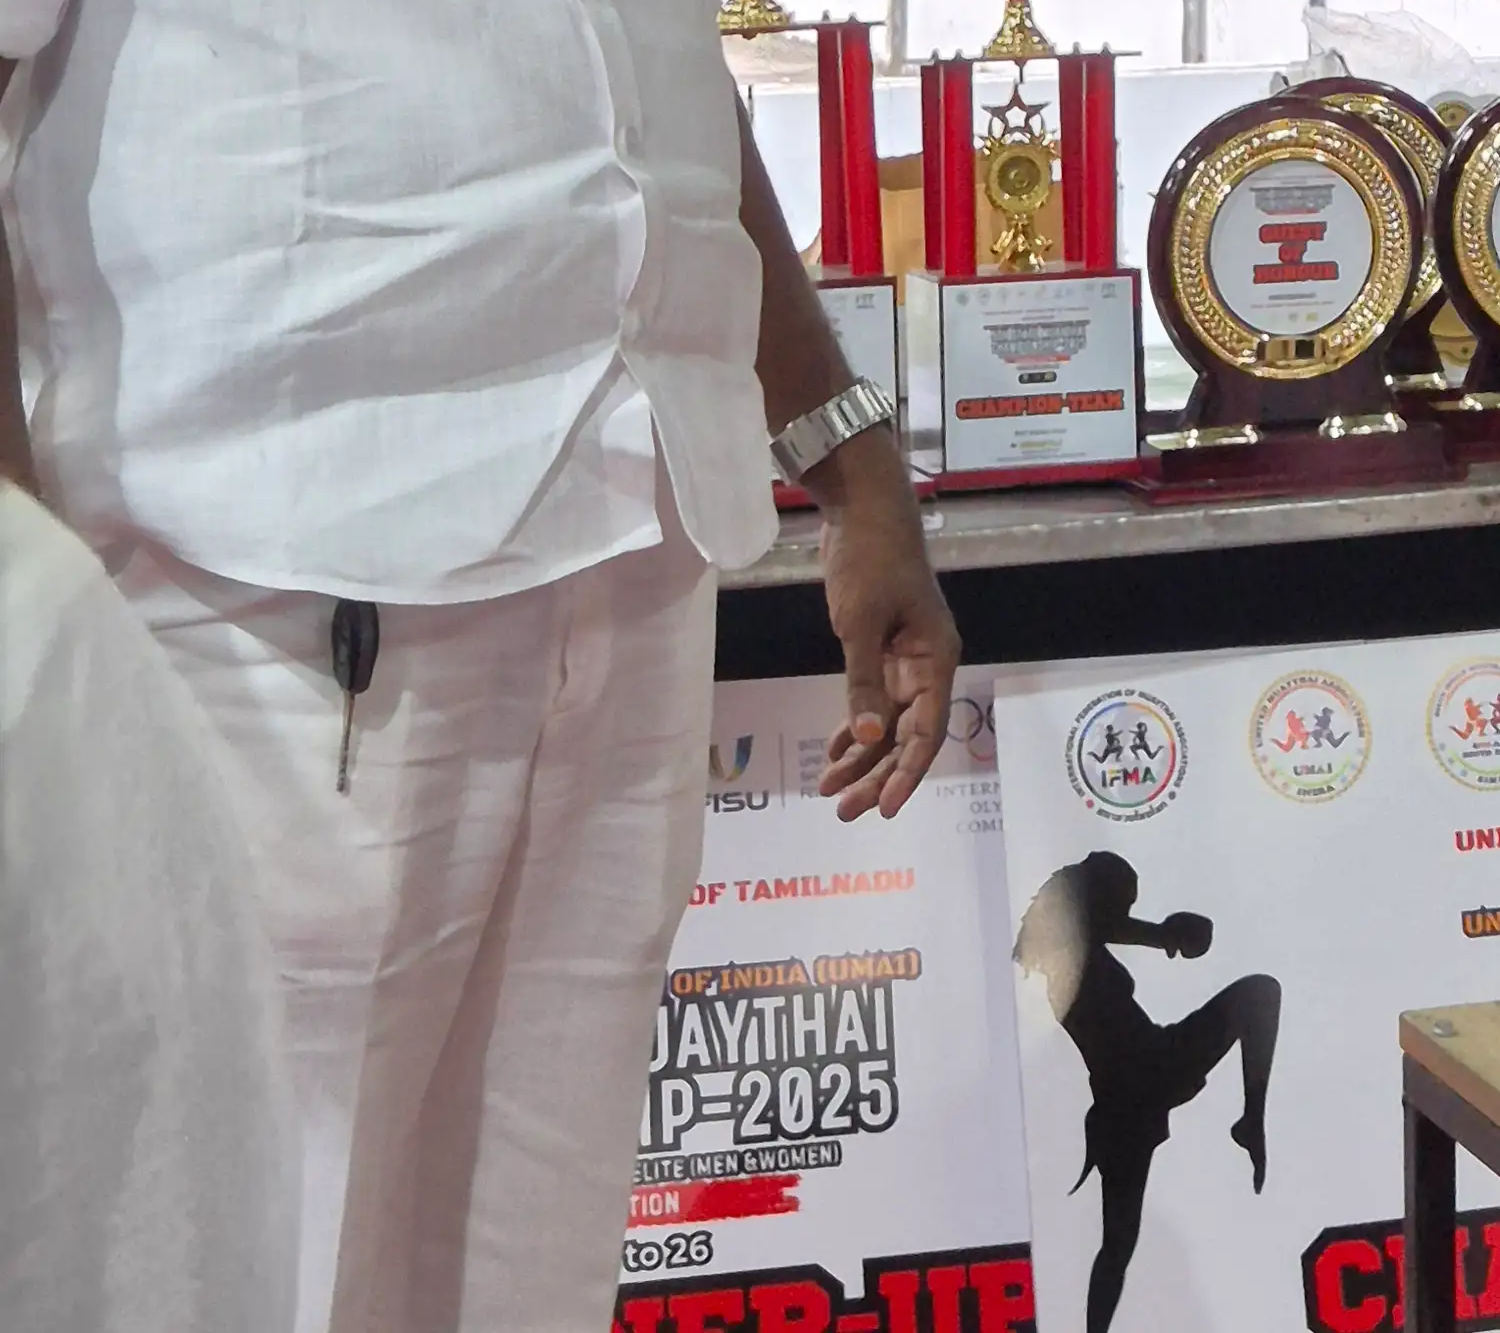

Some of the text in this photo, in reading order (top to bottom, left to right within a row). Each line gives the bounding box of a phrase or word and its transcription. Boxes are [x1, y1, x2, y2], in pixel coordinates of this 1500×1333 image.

[1101, 765, 1158, 789] IFMA
[688, 867, 915, 906] OF TAMILNADU
[673, 951, 919, 995] OF INDIA (UMAI)
